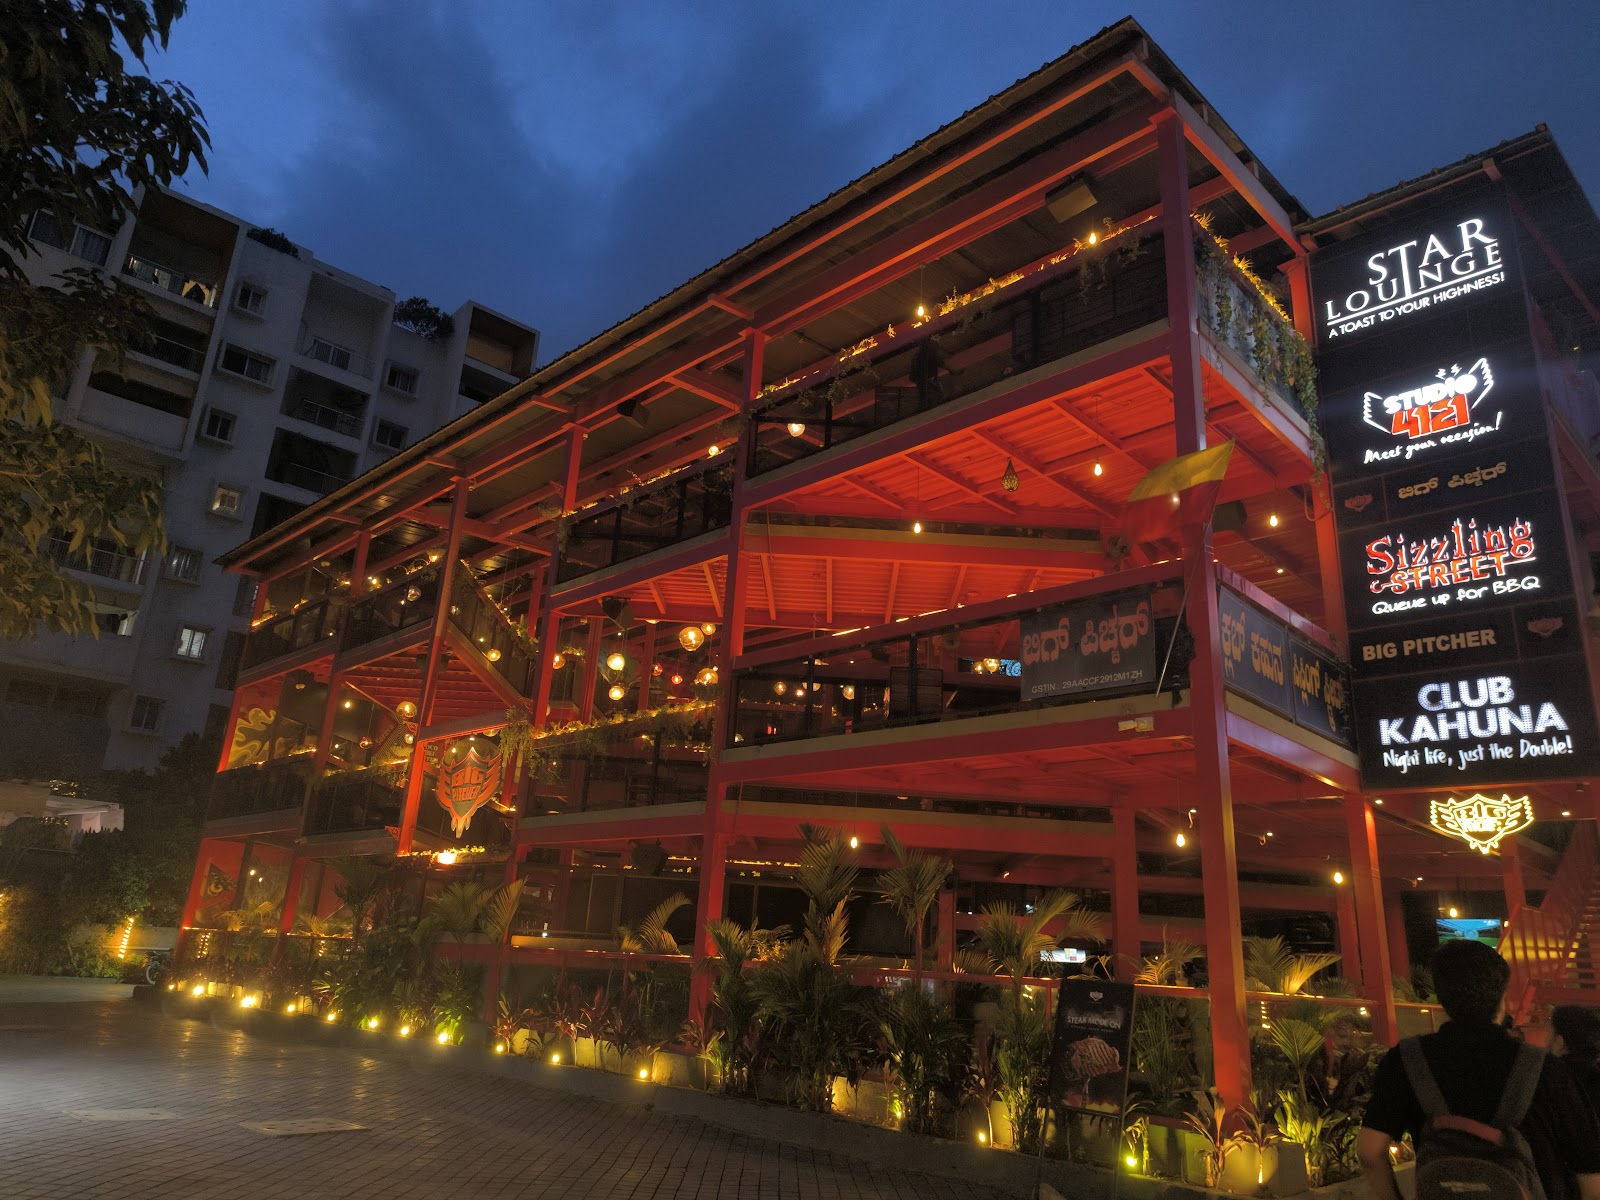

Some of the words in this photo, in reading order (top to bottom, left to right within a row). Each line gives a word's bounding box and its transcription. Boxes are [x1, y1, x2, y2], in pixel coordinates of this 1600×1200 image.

[1367, 218, 1498, 298] STAR
[1325, 242, 1502, 320] LOUNGE
[1328, 328, 1338, 339] A
[1339, 315, 1375, 335] TOAST
[1378, 309, 1395, 322] TO
[1395, 297, 1430, 316] YOUR
[1433, 271, 1505, 304] HIGHNESS!
[1383, 374, 1477, 415] STUDIO
[1363, 445, 1403, 464] Meet
[1405, 439, 1438, 460] your
[1440, 411, 1503, 443] occasion!
[1391, 393, 1470, 440] 4121
[1365, 517, 1535, 575] Sizzling
[1390, 550, 1509, 594] STREET
[1372, 597, 1428, 615] Queue
[1432, 592, 1451, 606] up
[1456, 585, 1489, 602] for
[1493, 575, 1541, 596] BBQ
[1362, 642, 1397, 662] BIG
[1403, 628, 1497, 656] PITCHER
[1031, 683, 1056, 694] GSTIN
[1417, 675, 1515, 712] CLUB
[1378, 701, 1569, 746] KAHUNA
[452, 762, 483, 786] BIG
[1382, 748, 1420, 774] Night
[1424, 746, 1453, 767] life,
[1457, 744, 1485, 771] just
[1489, 742, 1514, 760] the
[1519, 734, 1574, 759] Double!
[452, 785, 481, 801] PITCHER
